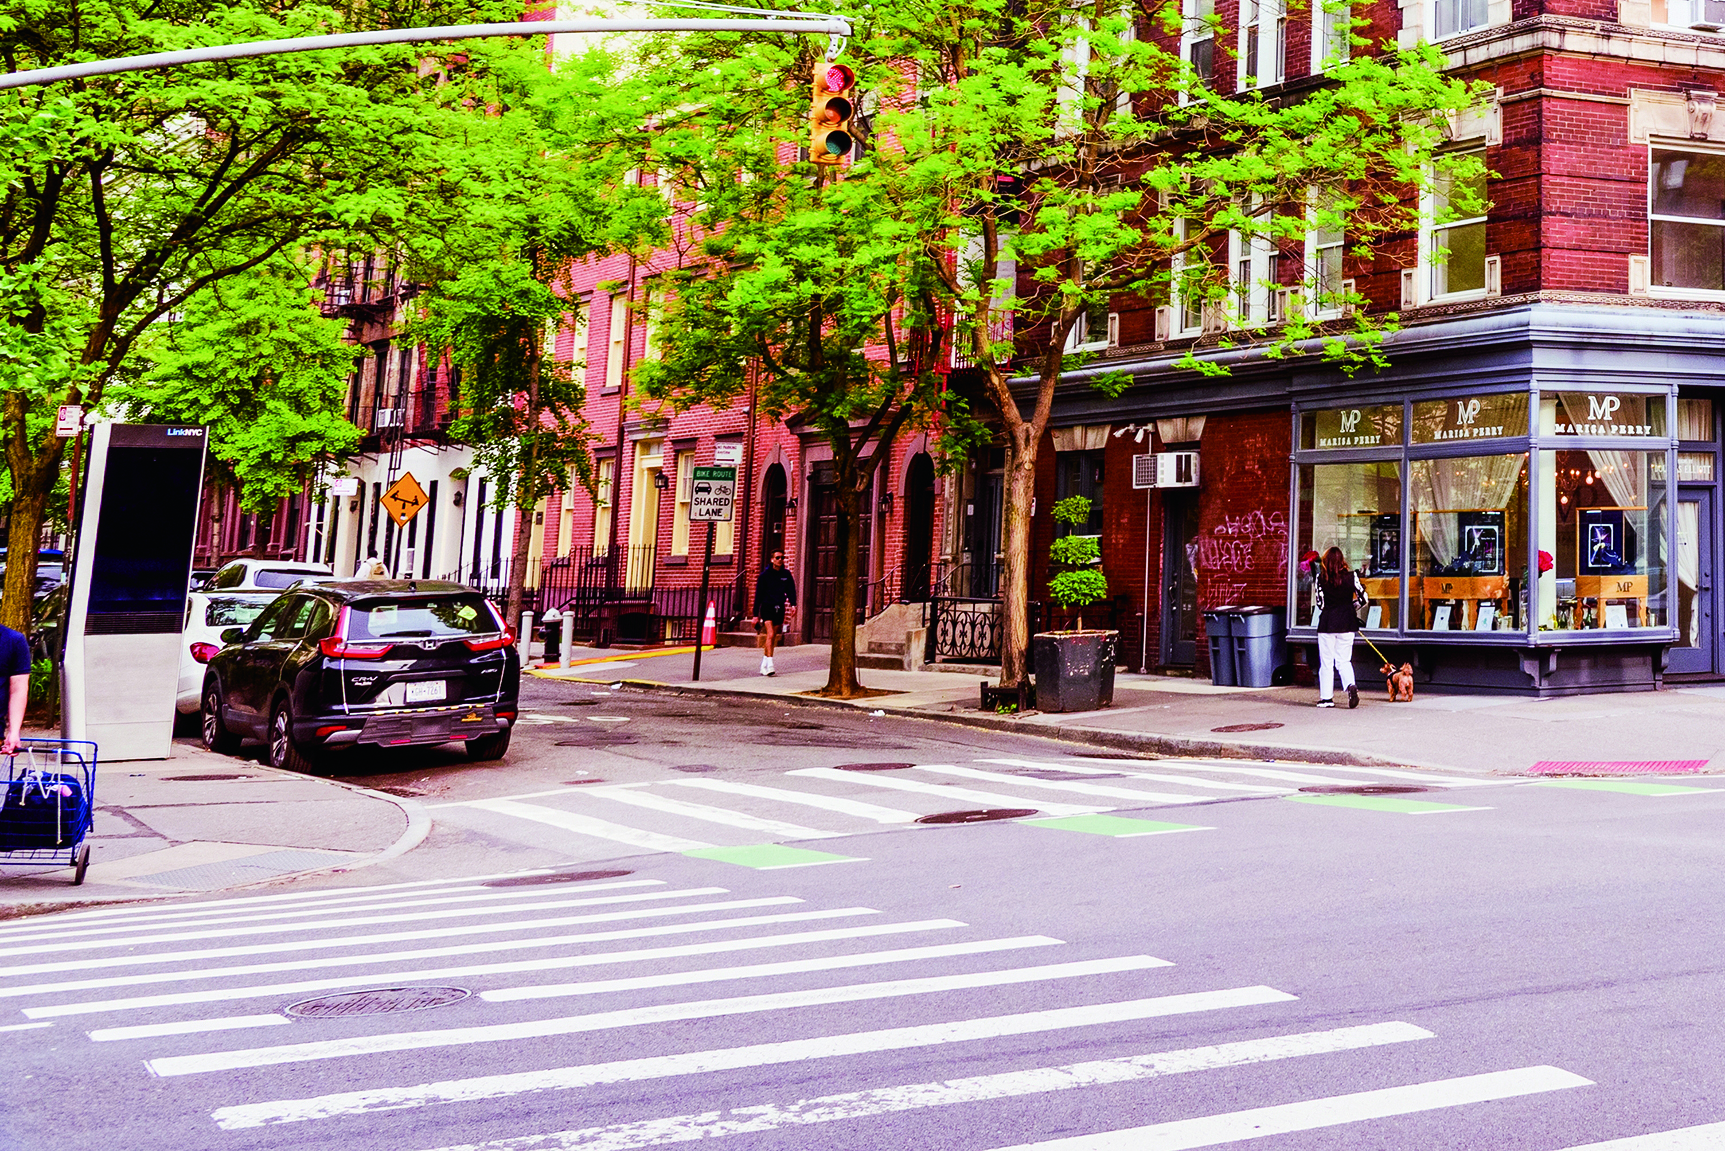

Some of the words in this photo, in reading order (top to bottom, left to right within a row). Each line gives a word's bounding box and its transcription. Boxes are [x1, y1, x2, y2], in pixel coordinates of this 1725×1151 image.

[1456, 399, 1481, 425] MP
[1587, 395, 1621, 421] MP
[1340, 409, 1361, 433] MP
[167, 428, 203, 436] LinkNYC
[1434, 428, 1470, 440] MARISA
[1473, 426, 1504, 438] PERRY
[1555, 423, 1607, 435] MARISA
[1610, 424, 1652, 436] PERRY
[1319, 436, 1351, 448] MARISA
[1354, 434, 1381, 446] PERRY
[696, 470, 710, 478] BIKE
[712, 470, 733, 478] ROUTE
[694, 497, 730, 506] SHARED
[699, 508, 723, 517] LANE
[1441, 582, 1453, 594] MP
[1616, 581, 1633, 593] MP
